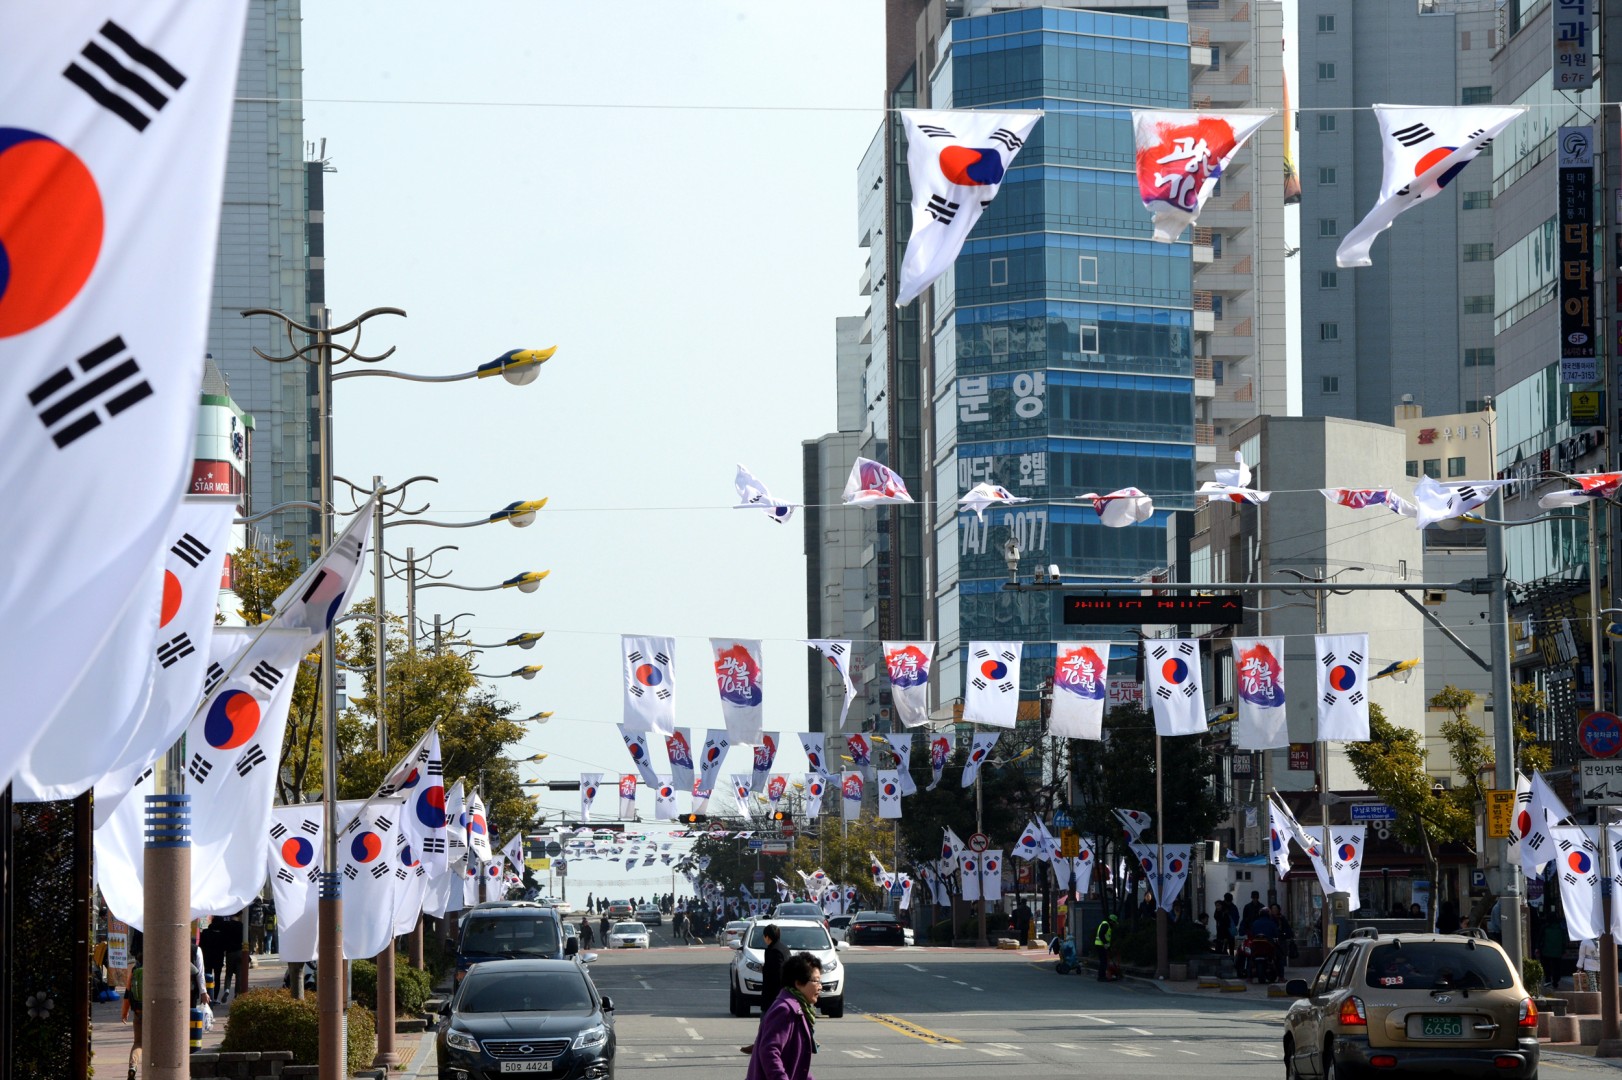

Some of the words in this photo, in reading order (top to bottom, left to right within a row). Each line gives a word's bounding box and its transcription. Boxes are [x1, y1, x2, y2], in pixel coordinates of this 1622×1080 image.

[1559, 53, 1586, 67] 의원
[1577, 172, 1586, 219] 마사지
[1571, 334, 1585, 343] 5F
[1019, 451, 1046, 486] 호텔
[194, 482, 214, 491] STAR
[959, 514, 989, 556] 747
[718, 656, 751, 688] 광복
[1062, 666, 1097, 693] 70주년
[1063, 655, 1096, 682] 광복
[1241, 657, 1273, 688] 광복
[717, 673, 753, 699] 70주년
[1242, 674, 1275, 699] 70주년
[1586, 731, 1619, 739] 주정차금지
[1290, 751, 1309, 760] 돼지
[1425, 1023, 1461, 1035] 6650
[526, 1062, 549, 1071] 4424
